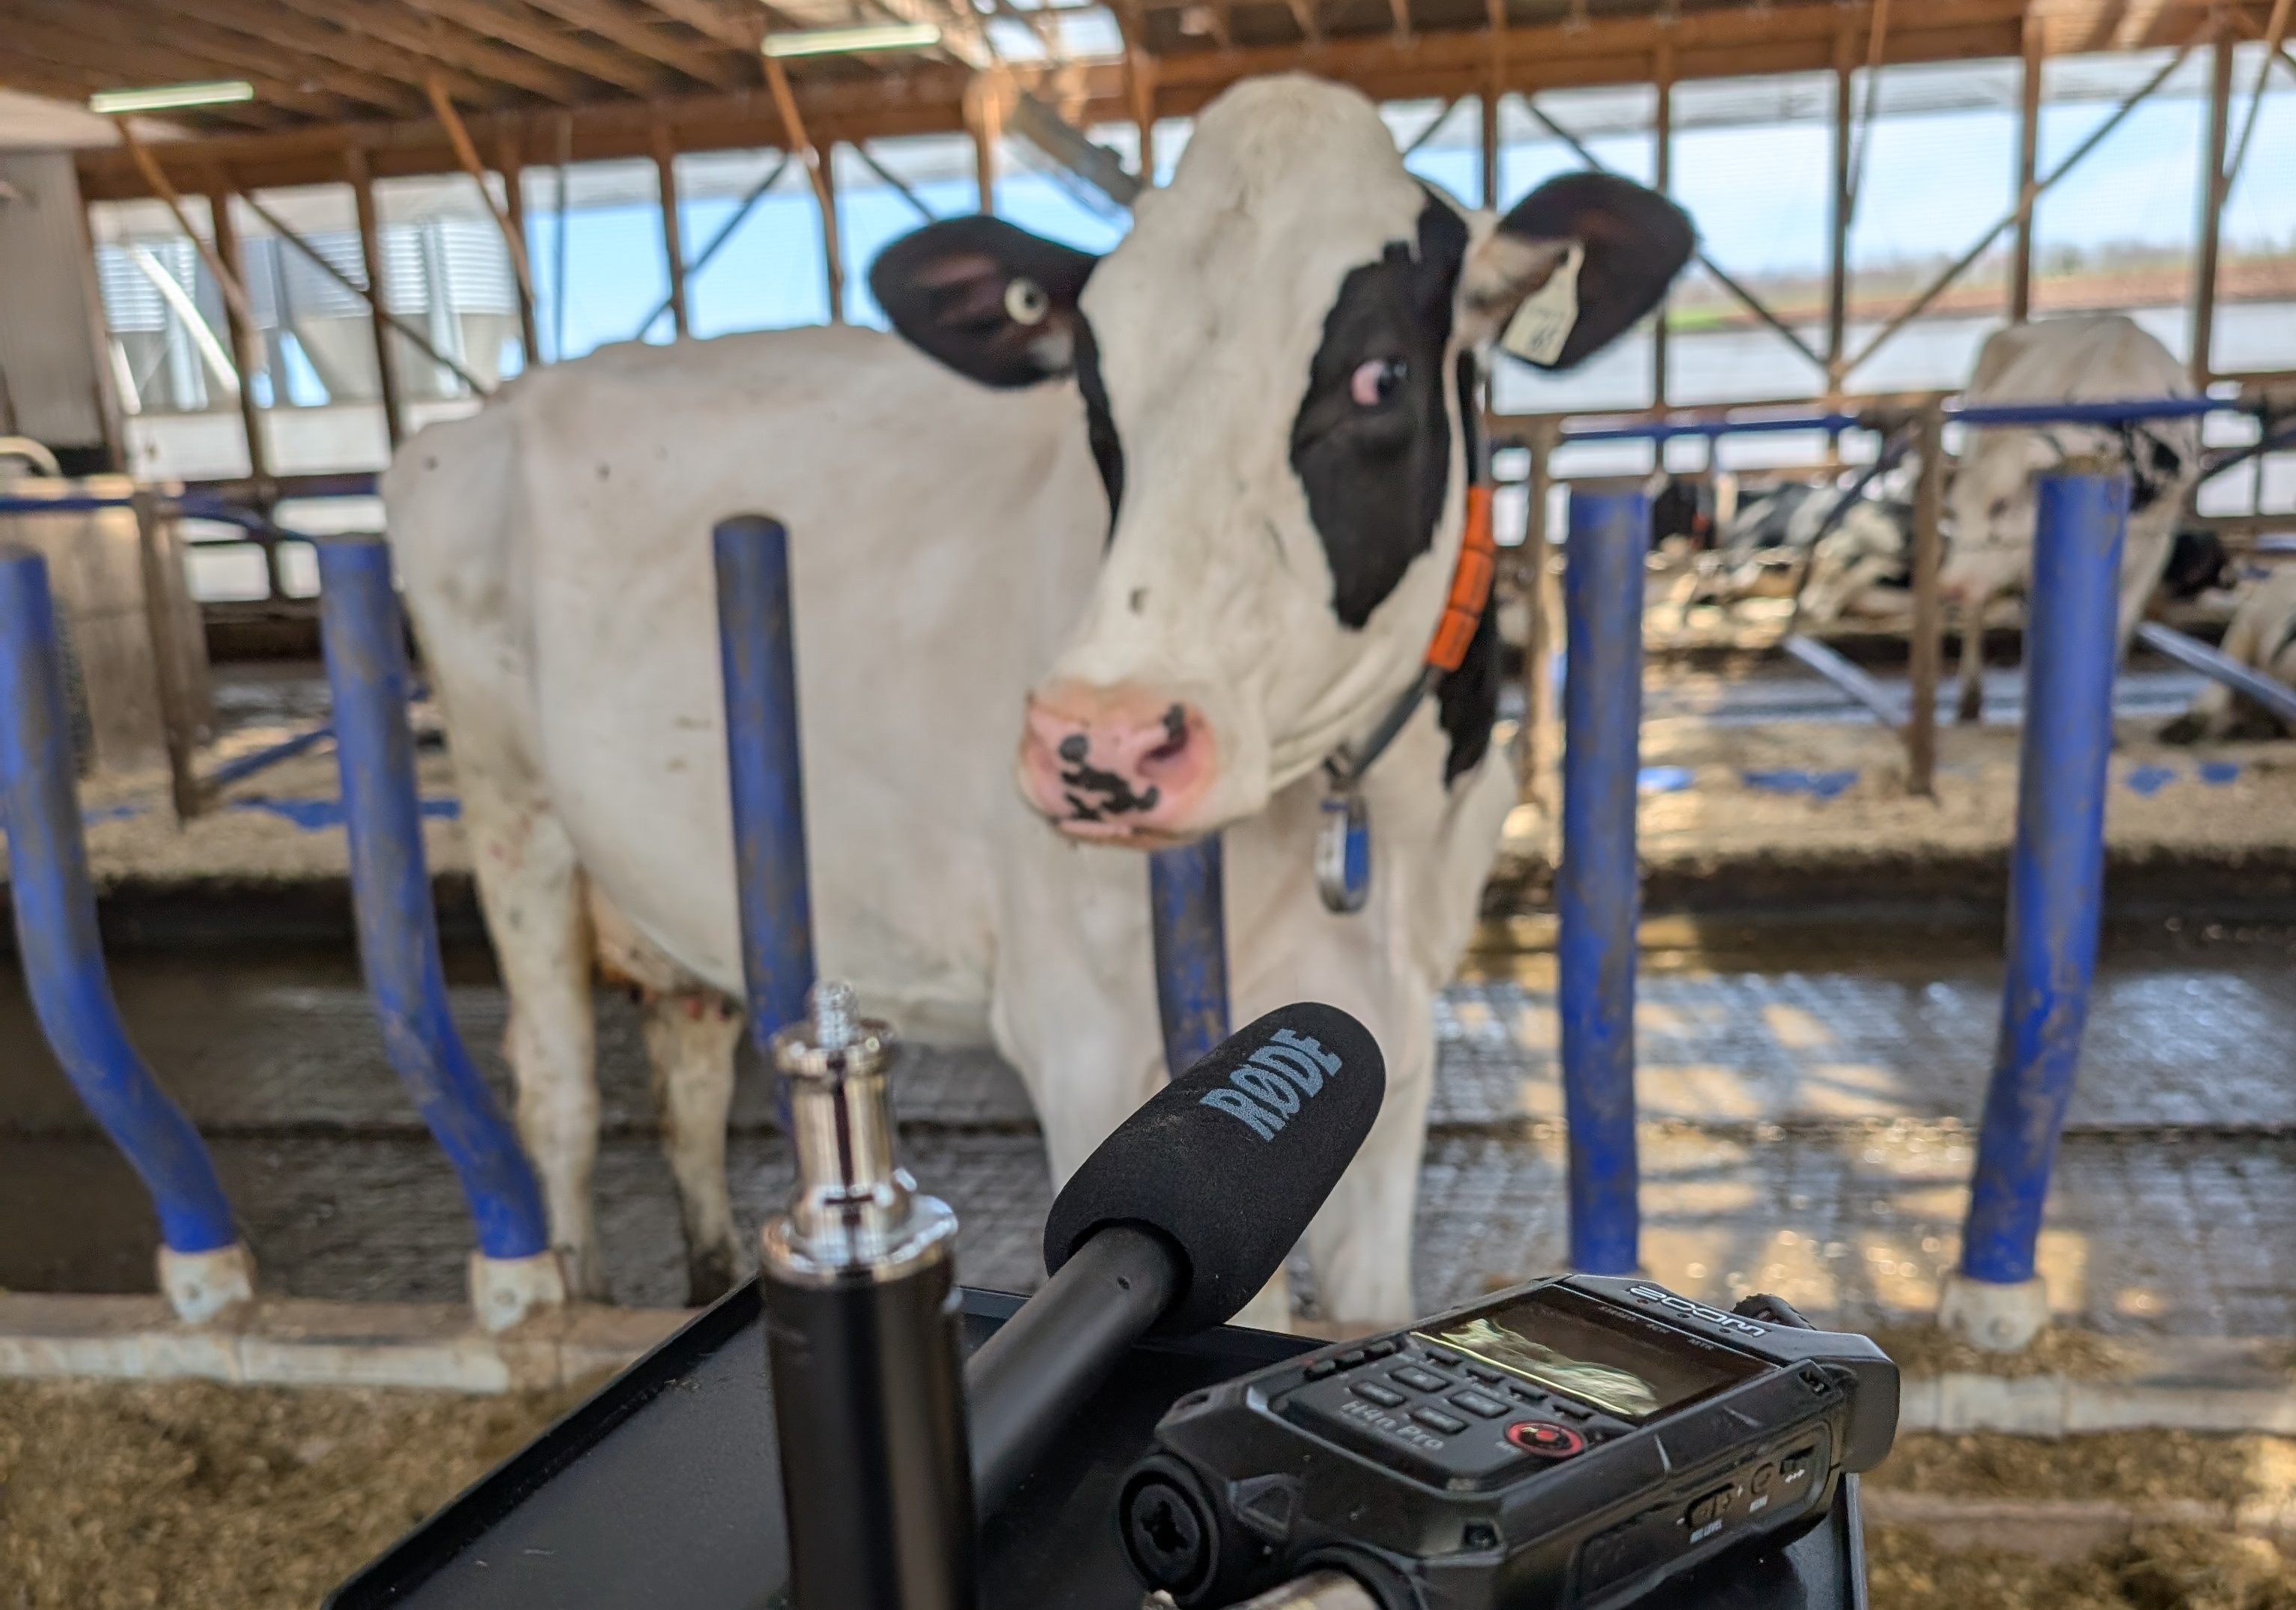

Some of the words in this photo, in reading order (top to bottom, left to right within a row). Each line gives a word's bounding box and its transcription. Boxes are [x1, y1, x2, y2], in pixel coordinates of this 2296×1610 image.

[1199, 1028, 1342, 1143] RØDE
[1341, 1400, 1397, 1430] H4n
[1395, 1424, 1445, 1451] Pro
